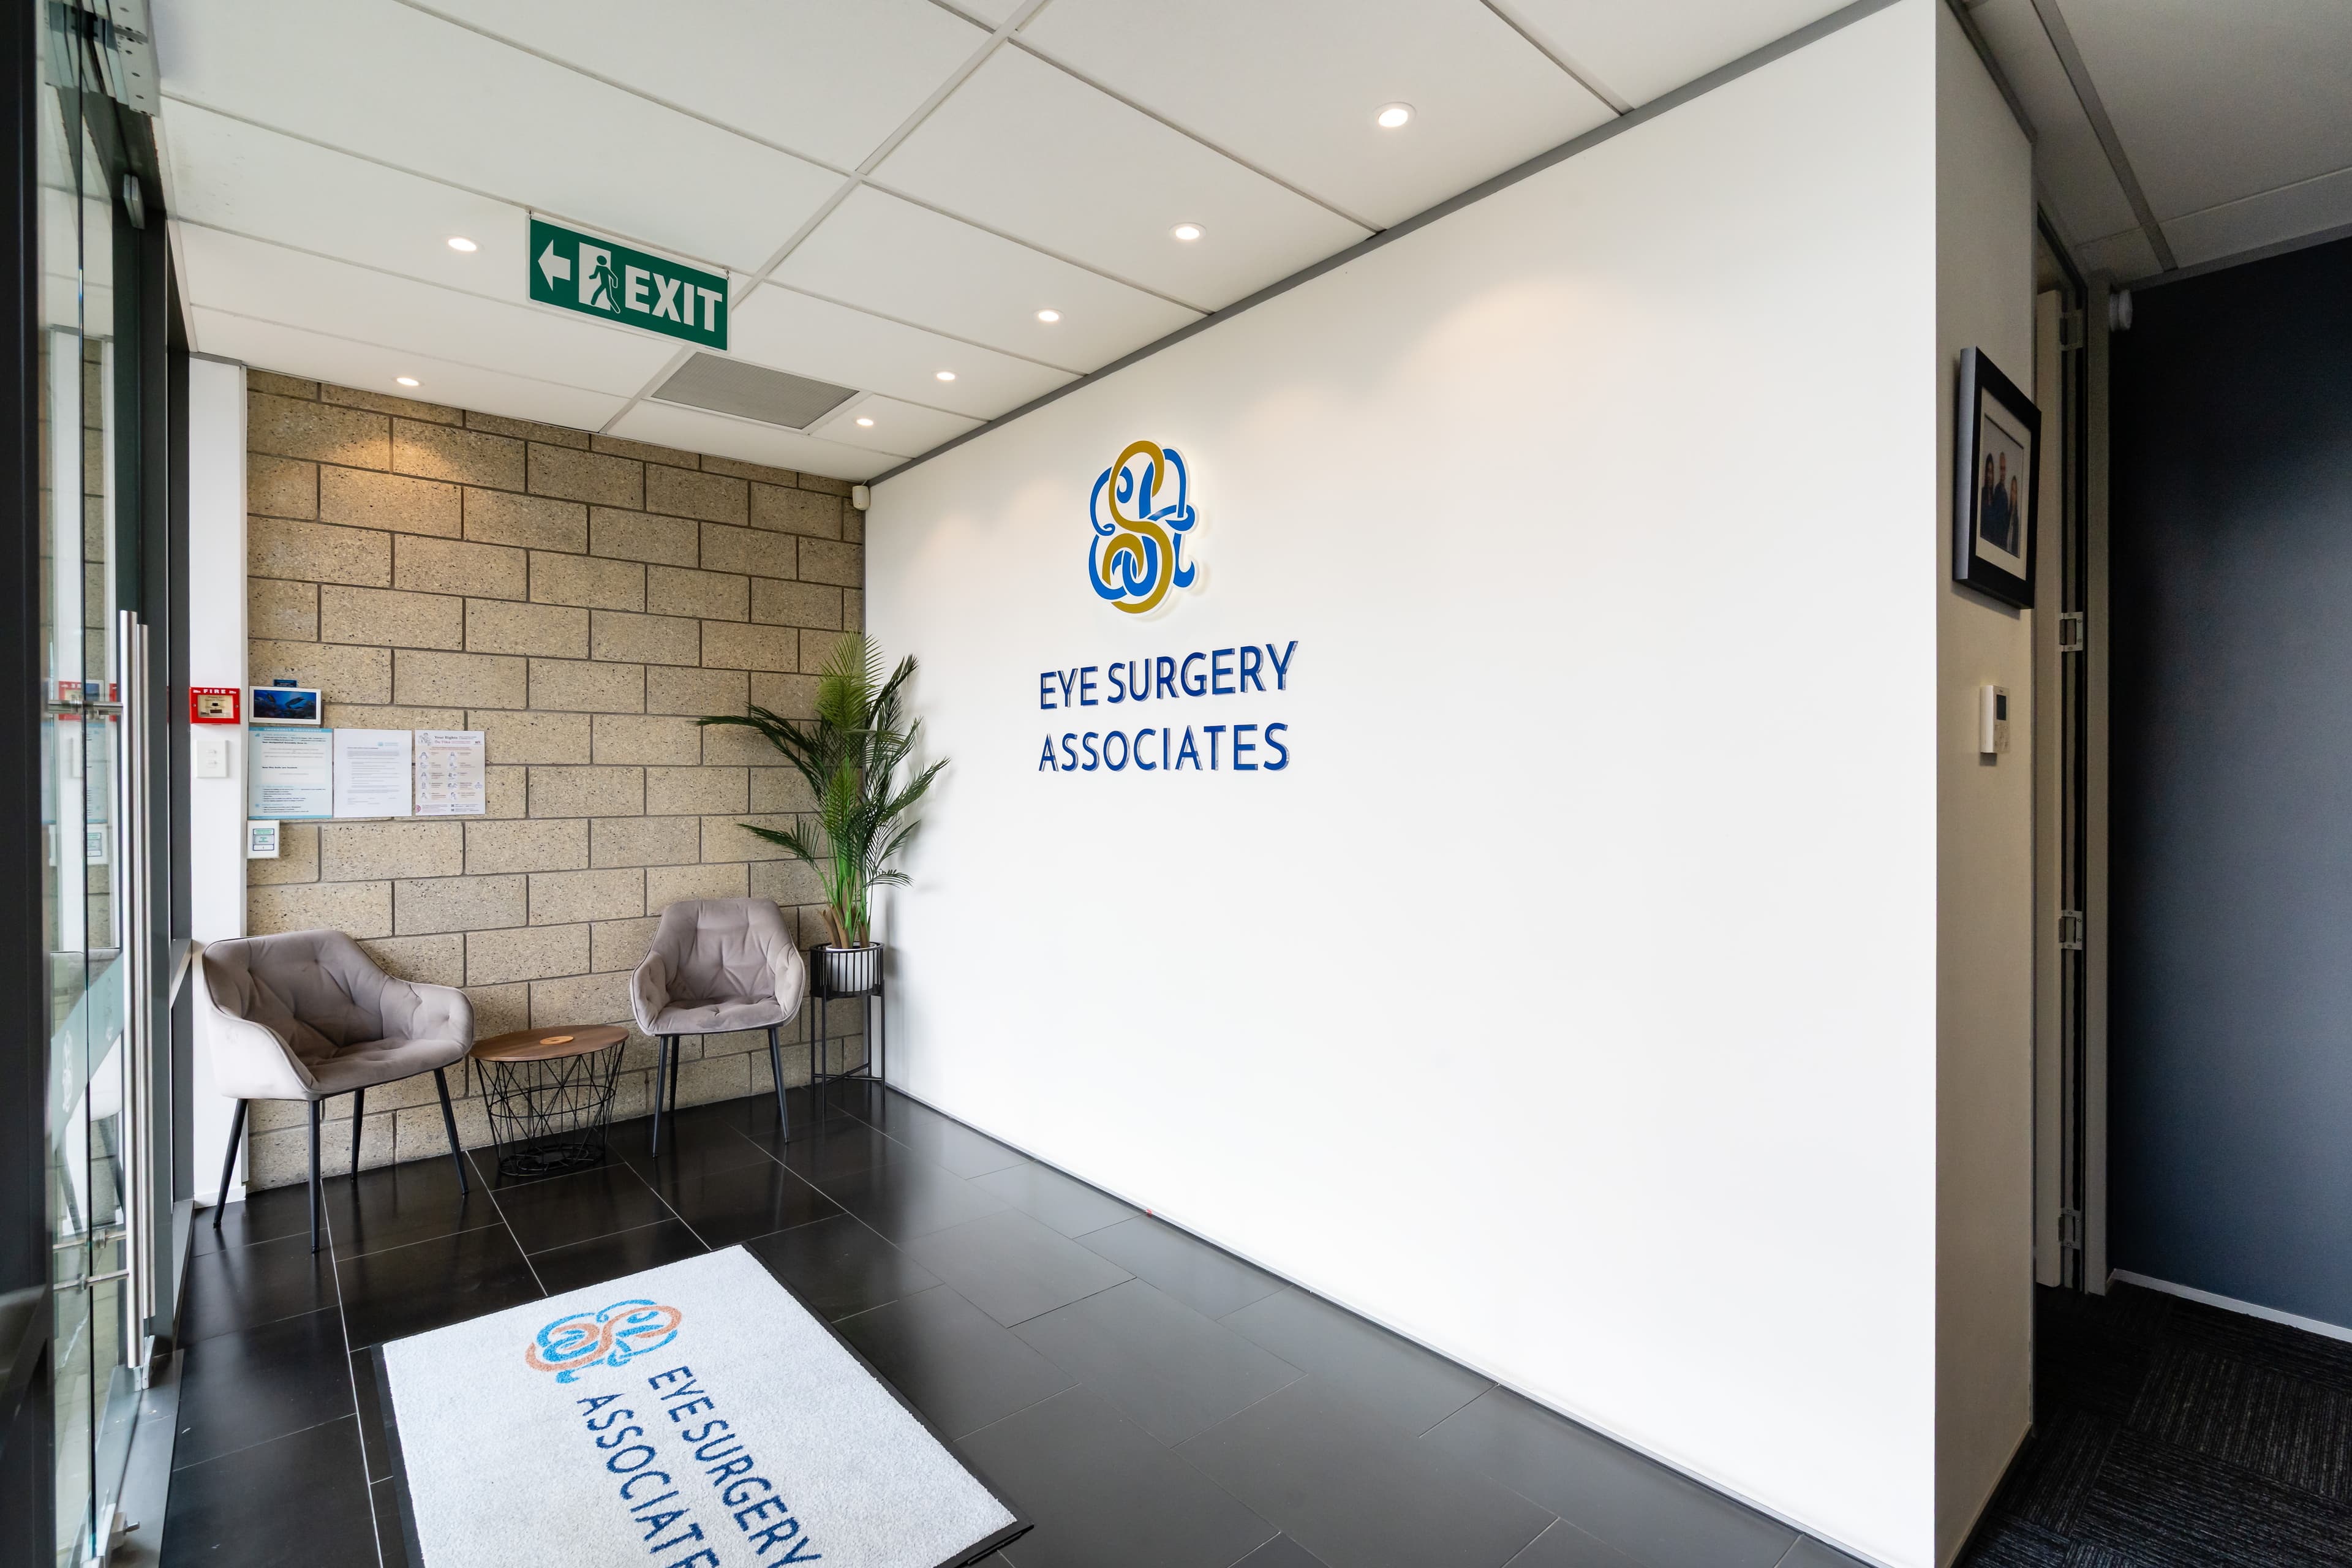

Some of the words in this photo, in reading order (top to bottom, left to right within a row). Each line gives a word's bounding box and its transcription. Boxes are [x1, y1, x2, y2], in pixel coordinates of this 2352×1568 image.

[625, 265, 723, 332] EXIT
[1041, 665, 1099, 710] EYE
[1107, 640, 1299, 704] SURGERY
[1038, 722, 1290, 772] ASSOCIATES
[647, 1365, 715, 1423] EYE
[682, 1419, 822, 1568] SURGERY
